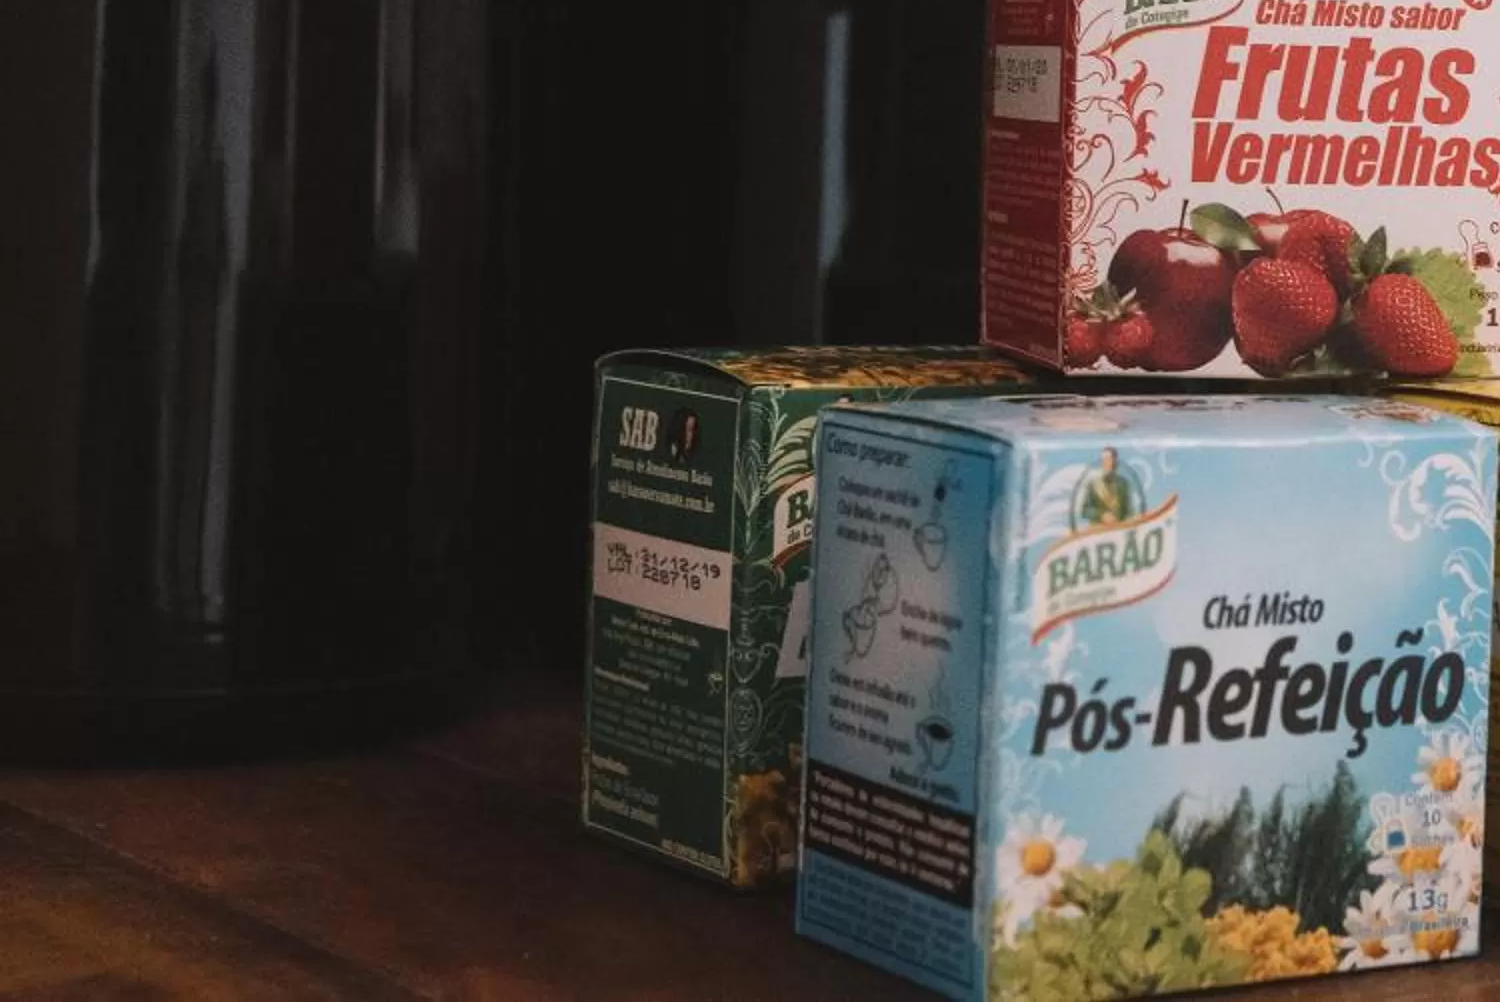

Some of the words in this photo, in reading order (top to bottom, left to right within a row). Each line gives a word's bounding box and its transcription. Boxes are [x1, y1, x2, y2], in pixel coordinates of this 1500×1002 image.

[1311, 0, 1385, 28] Misto
[1390, 4, 1466, 31] sabor
[1192, 25, 1475, 125] Frutas
[619, 405, 660, 452] SAB
[1049, 527, 1165, 596] BARÃO
[1203, 593, 1251, 630] Chá
[1255, 593, 1326, 626] Misto
[1030, 628, 1466, 760] Pós-Refeição
[1422, 808, 1442, 828] 10
[1407, 888, 1450, 913] 13g
